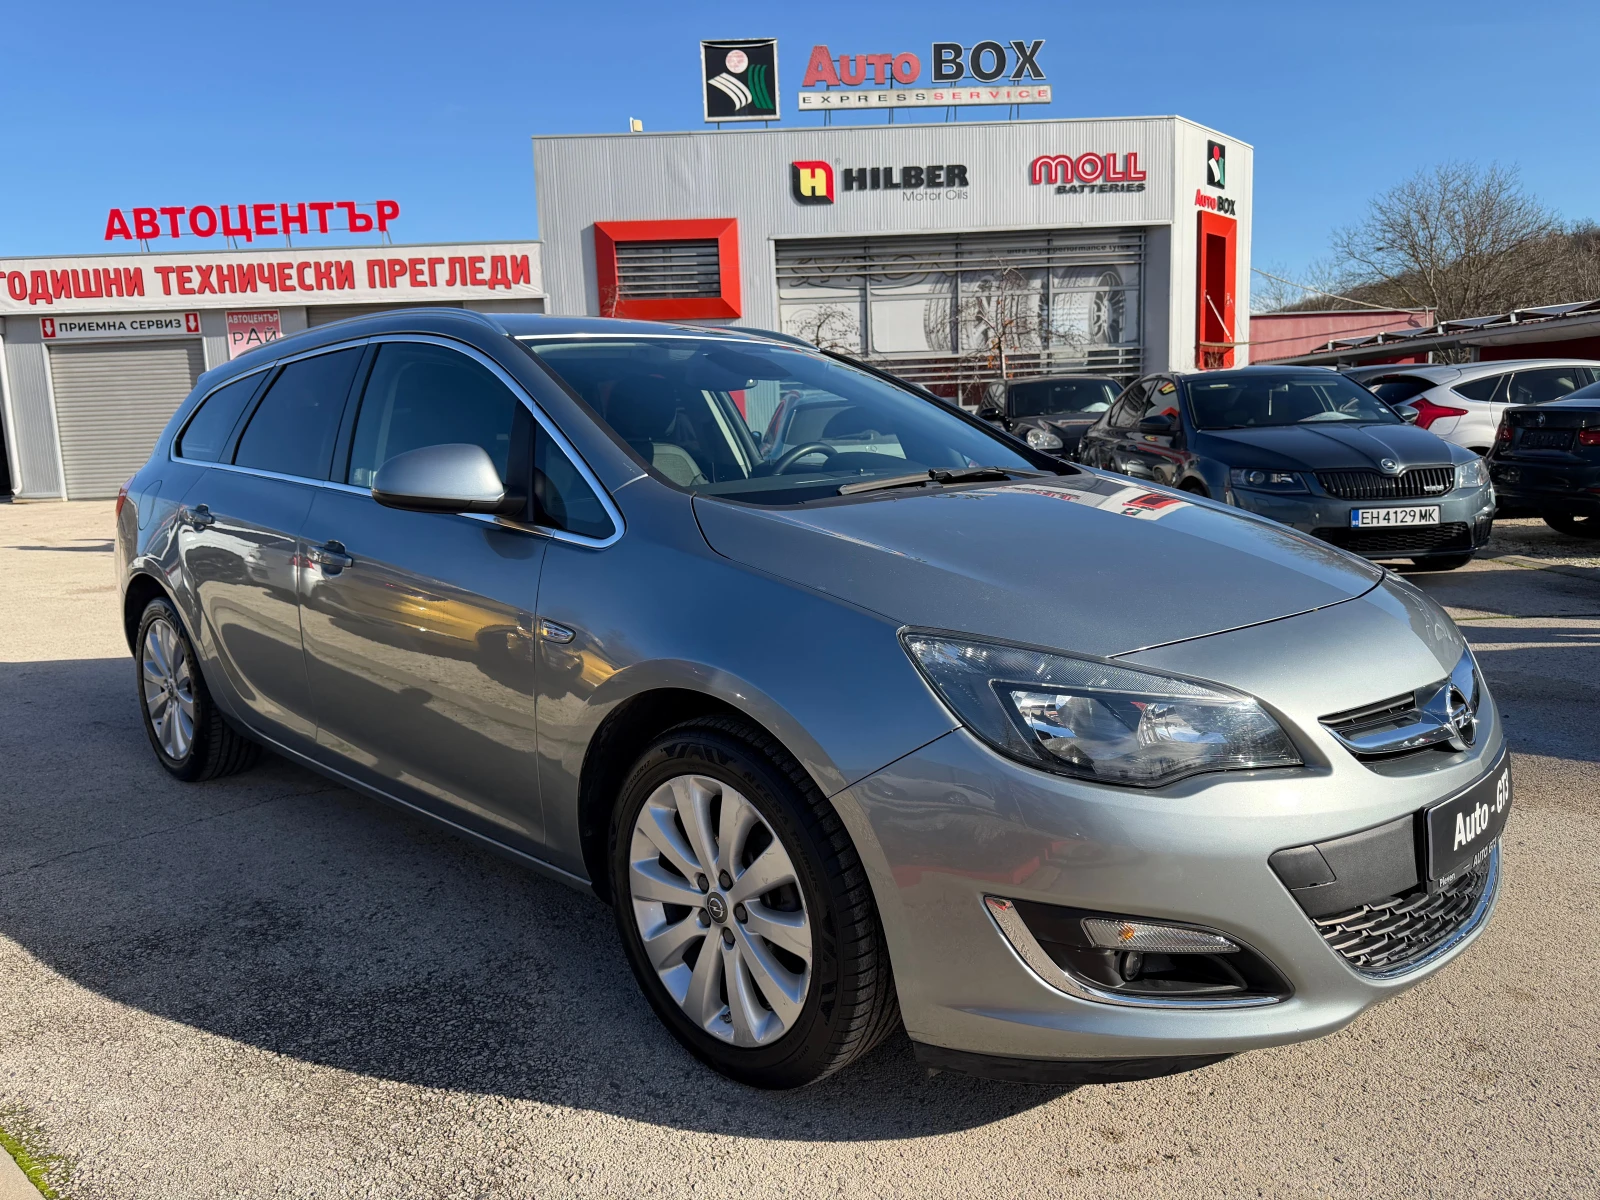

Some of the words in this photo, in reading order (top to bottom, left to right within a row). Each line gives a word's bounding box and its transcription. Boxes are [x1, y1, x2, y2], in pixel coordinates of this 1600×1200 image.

[931, 39, 1047, 83] BOX
[844, 164, 969, 191] HILBER
[902, 191, 941, 202] Motor
[945, 189, 968, 200] Oils
[1056, 183, 1146, 194] BATTERIES
[1217, 195, 1236, 216] BOX
[104, 200, 400, 242] АВТОЦЕНТЪР
[154, 260, 356, 296] ТЕХНИЧЕСКИ
[366, 254, 531, 290] ПРЕГЛЕДИ
[59, 321, 127, 332] ПРИЕМНА
[130, 318, 182, 330] СЕРВИЗ
[228, 313, 279, 324] АВТОЦЕНТЪР
[1361, 511, 1380, 524] EH
[1382, 509, 1417, 523] 4129
[1419, 508, 1437, 522] MK
[1453, 801, 1489, 851] Auto
[1496, 767, 1509, 814] GT3
